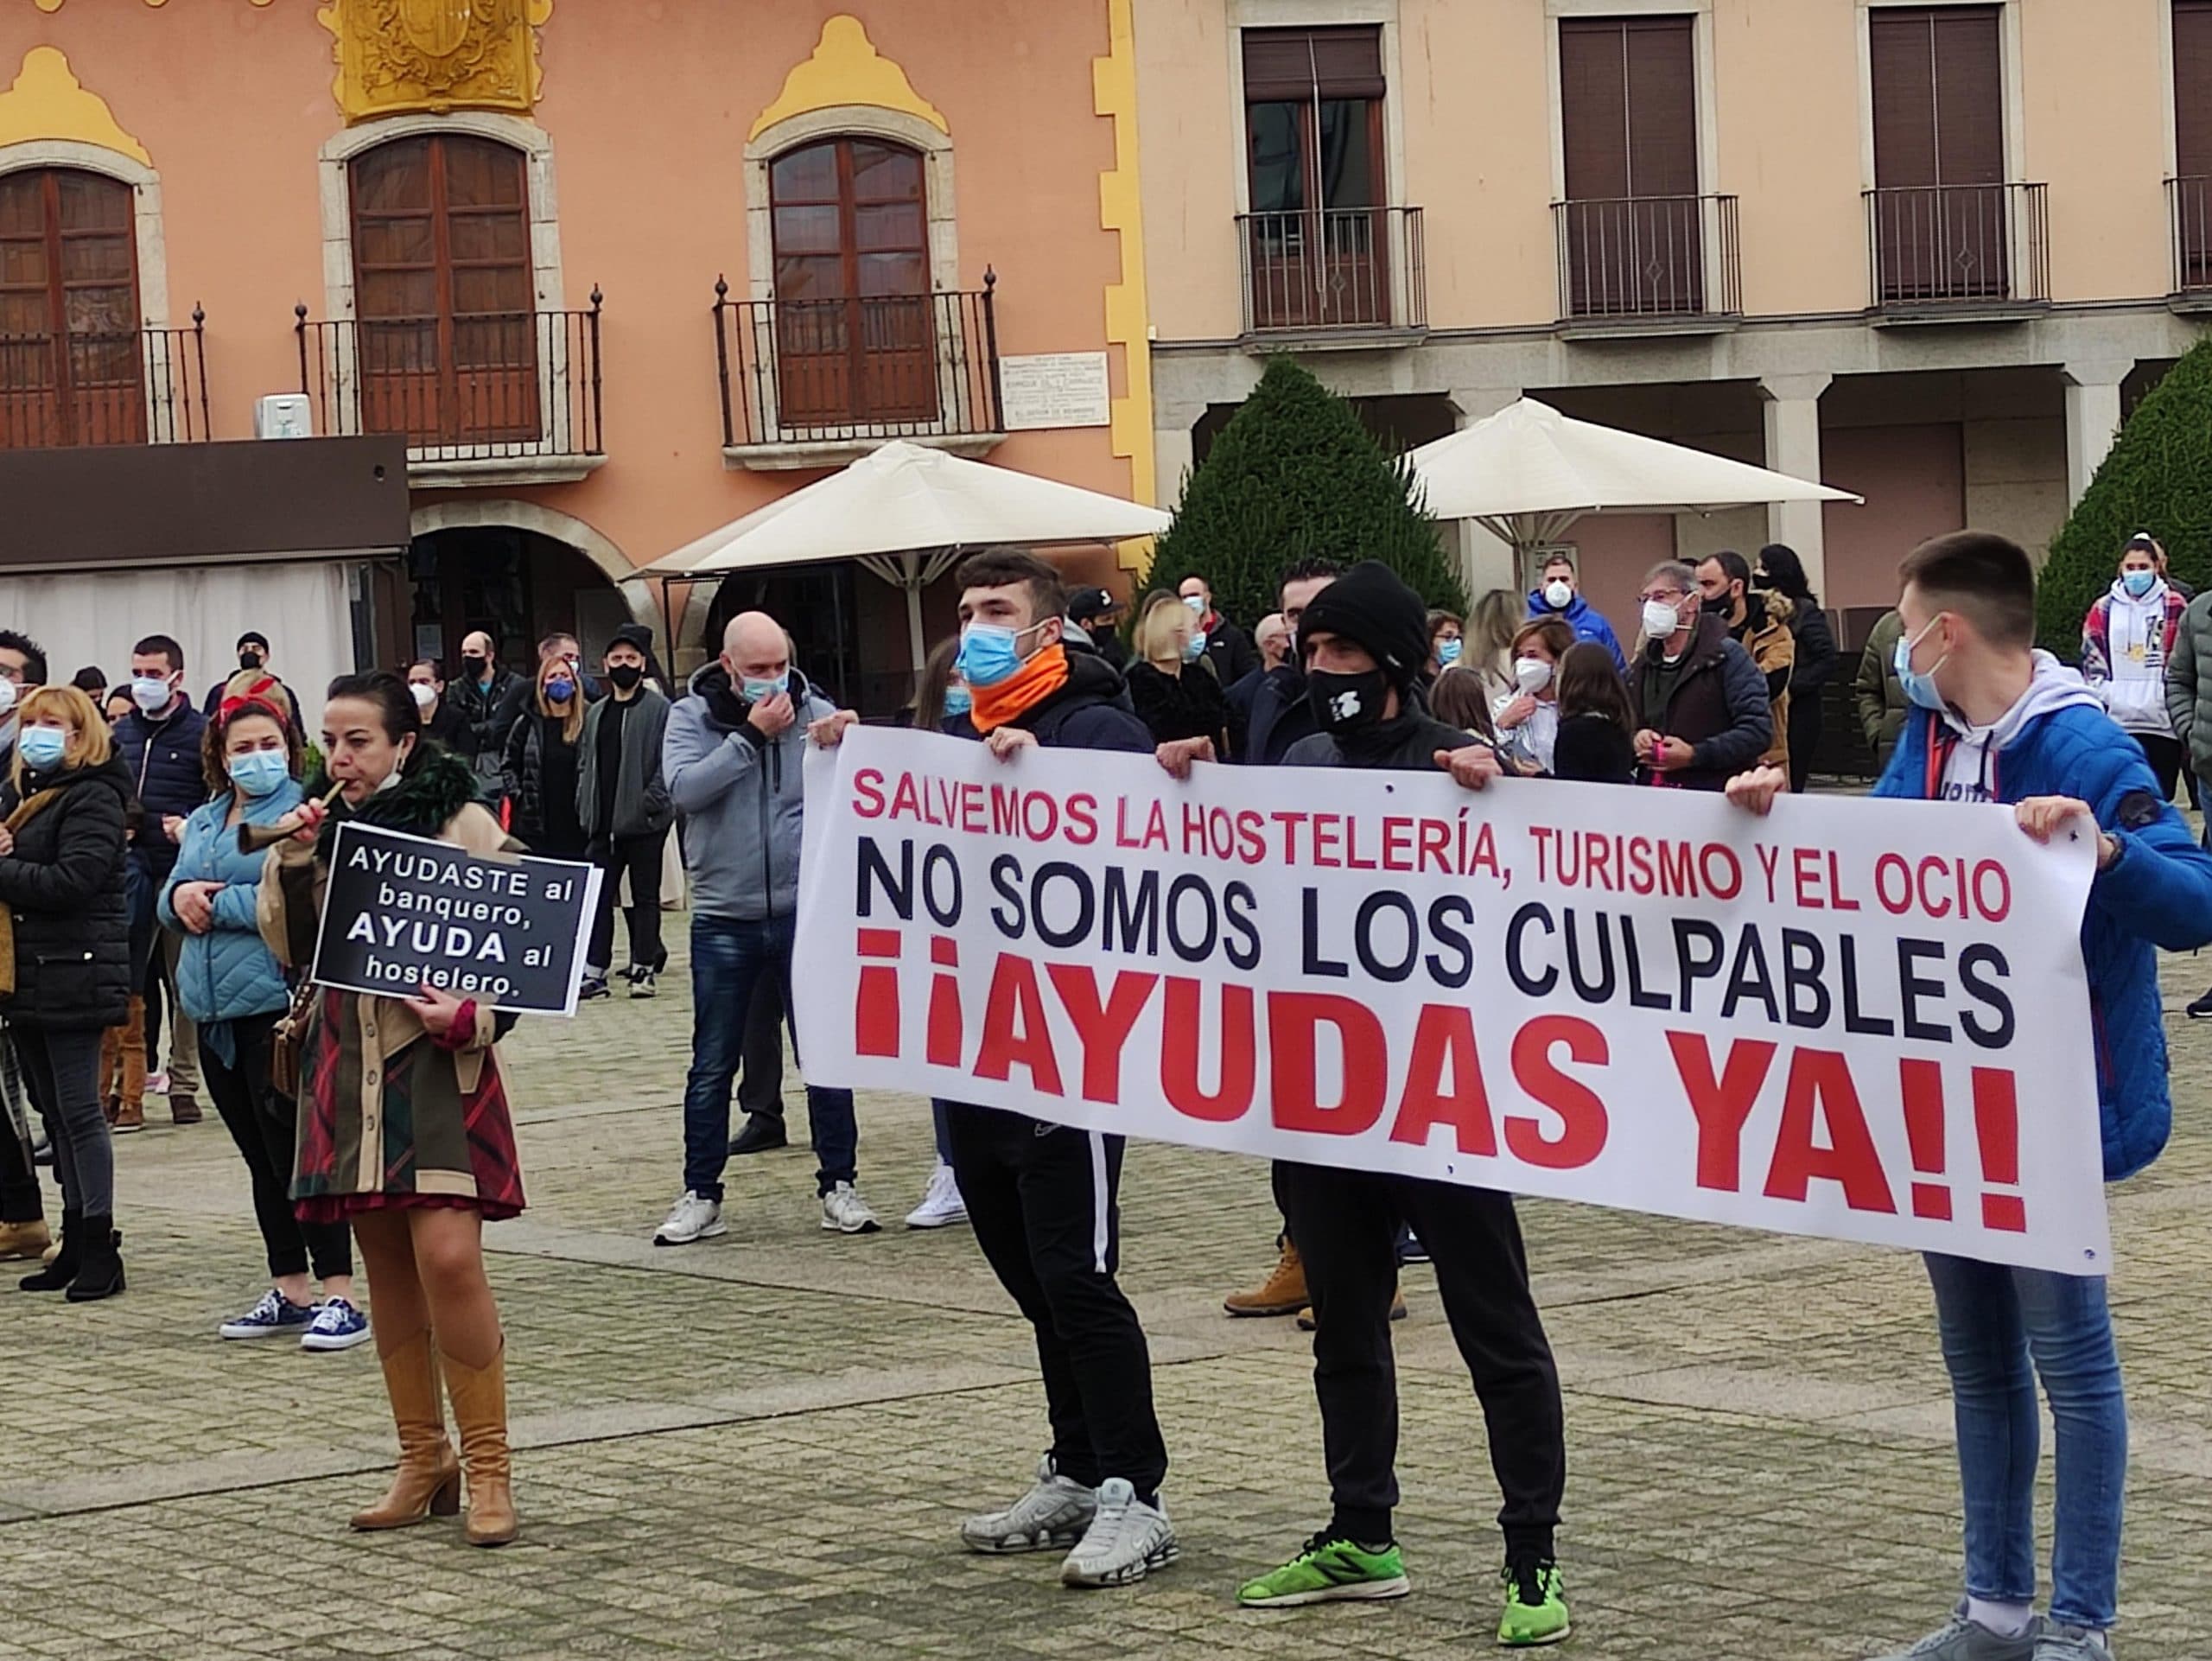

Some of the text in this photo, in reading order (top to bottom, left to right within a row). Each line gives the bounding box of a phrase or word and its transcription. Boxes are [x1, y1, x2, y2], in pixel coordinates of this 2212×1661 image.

[348, 845, 573, 902] AYUDASTE al
[852, 767, 2012, 923] SALVEMOS LA HOSTELERÍA, TURISMO Y EL OCIO
[378, 881, 531, 930] banquero,
[346, 911, 552, 968] AYUDA al
[855, 835, 2016, 1050] NO SOMOS LOS CULPABLES
[365, 954, 520, 997] hostelero.
[855, 927, 2027, 1233] ¡¡AYUDAS YA!!
